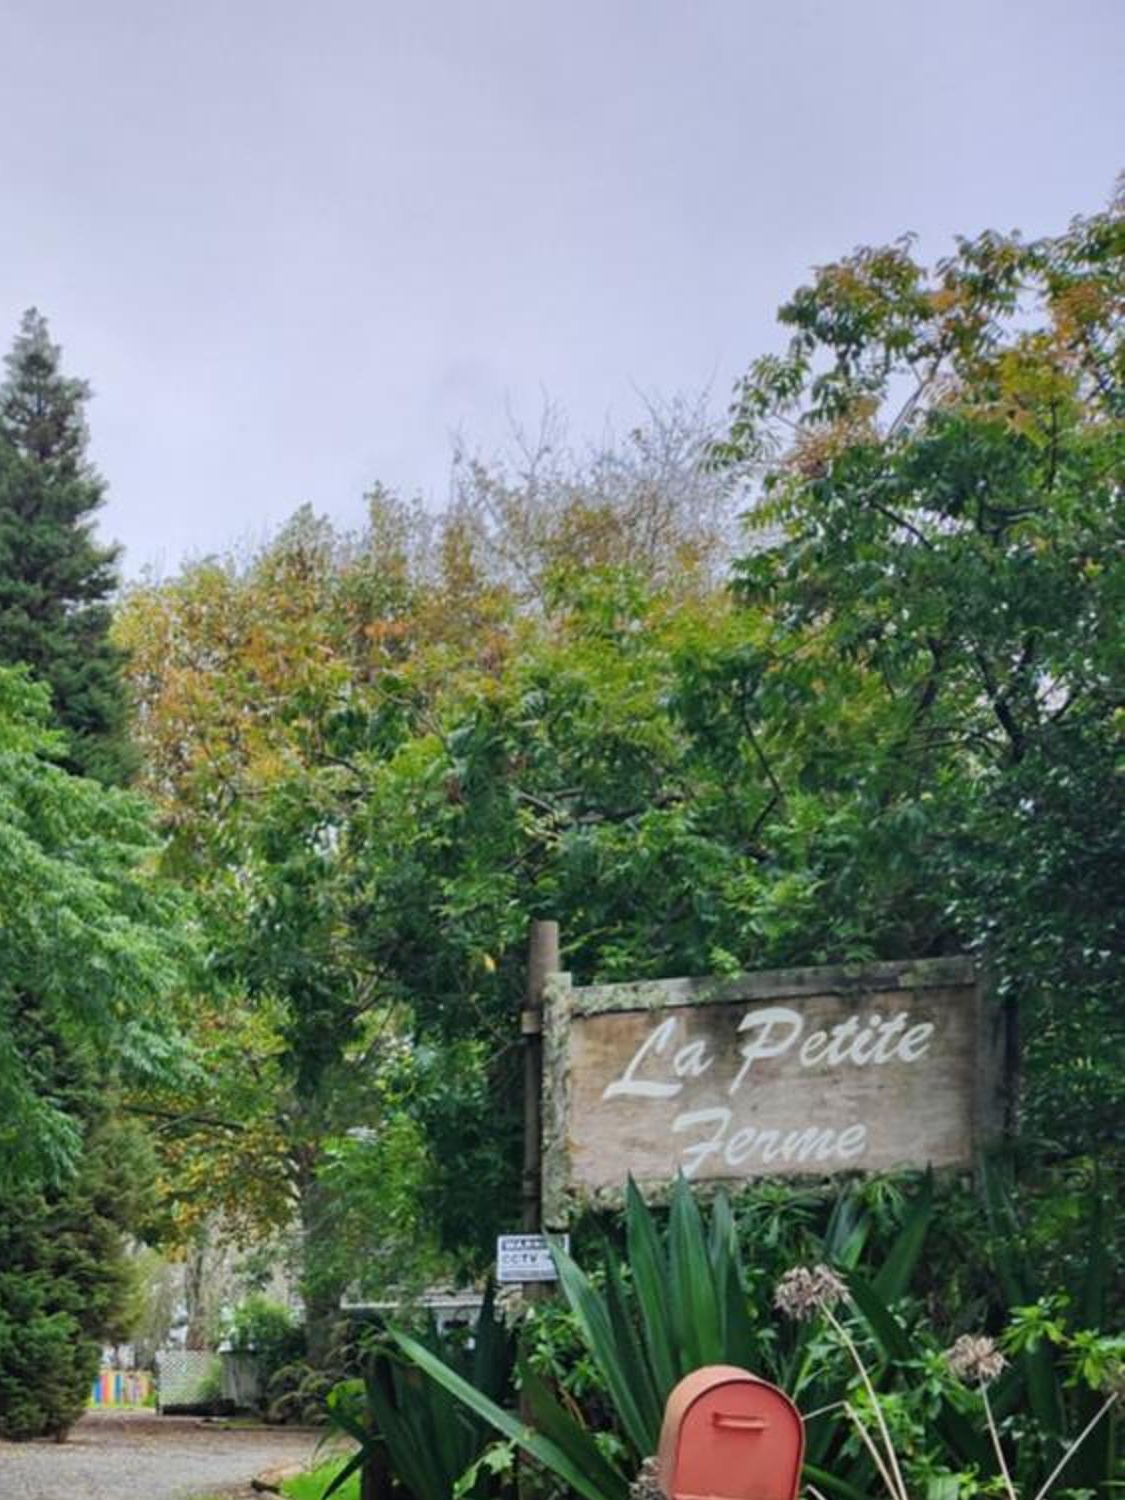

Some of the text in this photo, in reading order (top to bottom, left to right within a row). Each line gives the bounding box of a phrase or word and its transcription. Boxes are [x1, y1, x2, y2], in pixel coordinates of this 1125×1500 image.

[602, 1006, 936, 1100] La Petite
[671, 1106, 868, 1180] Ferme
